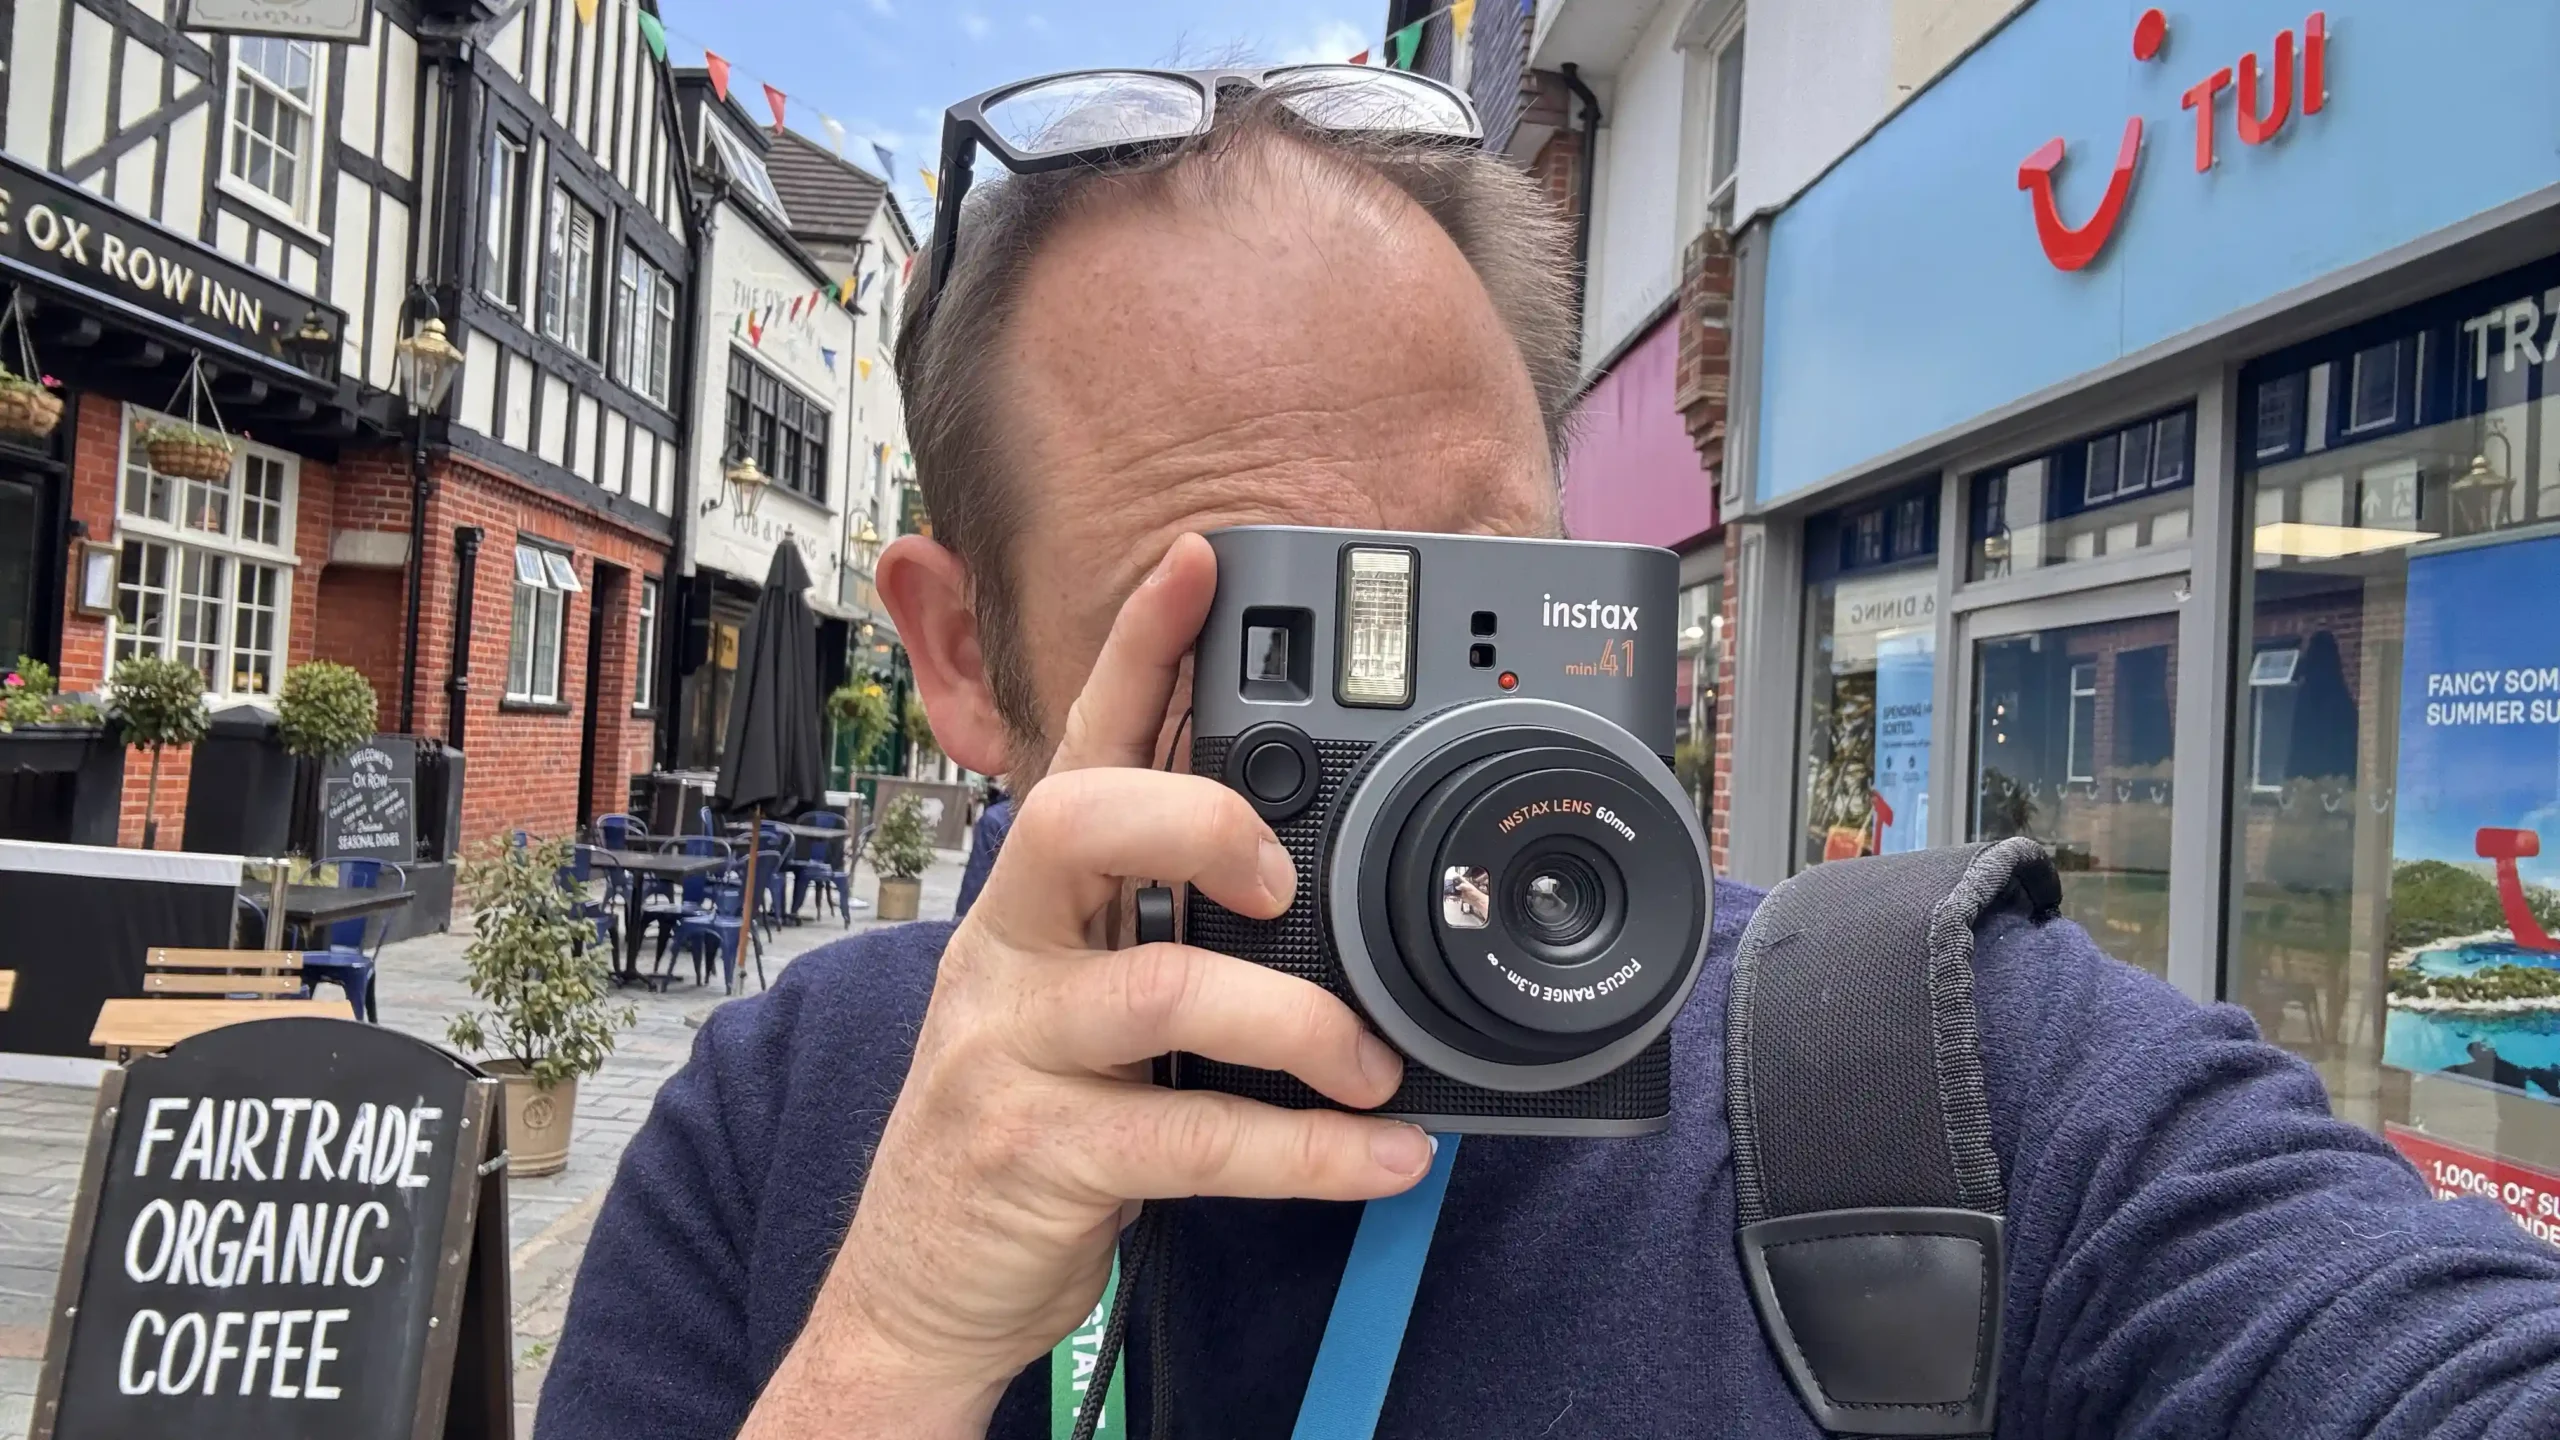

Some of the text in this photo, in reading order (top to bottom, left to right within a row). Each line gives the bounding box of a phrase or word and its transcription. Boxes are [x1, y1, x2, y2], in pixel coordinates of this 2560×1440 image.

[2182, 11, 2325, 174] TUI
[25, 203, 90, 266] OX
[101, 232, 194, 304] ROW
[199, 275, 262, 335] INN
[1543, 593, 1639, 631] instax
[1565, 638, 1634, 677] mini 41
[2428, 670, 2500, 697] FANCY
[2426, 702, 2525, 726] SUMMER
[1498, 799, 1636, 842] INSTAX LENS 60mm
[1507, 969, 1540, 997] 0.3m
[1542, 985, 1596, 1003] RANGE
[1597, 958, 1642, 996] FOCUS
[134, 1097, 443, 1188] FAIRTRADE
[2433, 1160, 2499, 1199] 1,000s
[125, 1199, 390, 1288] ORGANIC
[118, 1308, 350, 1400] COFFEE
